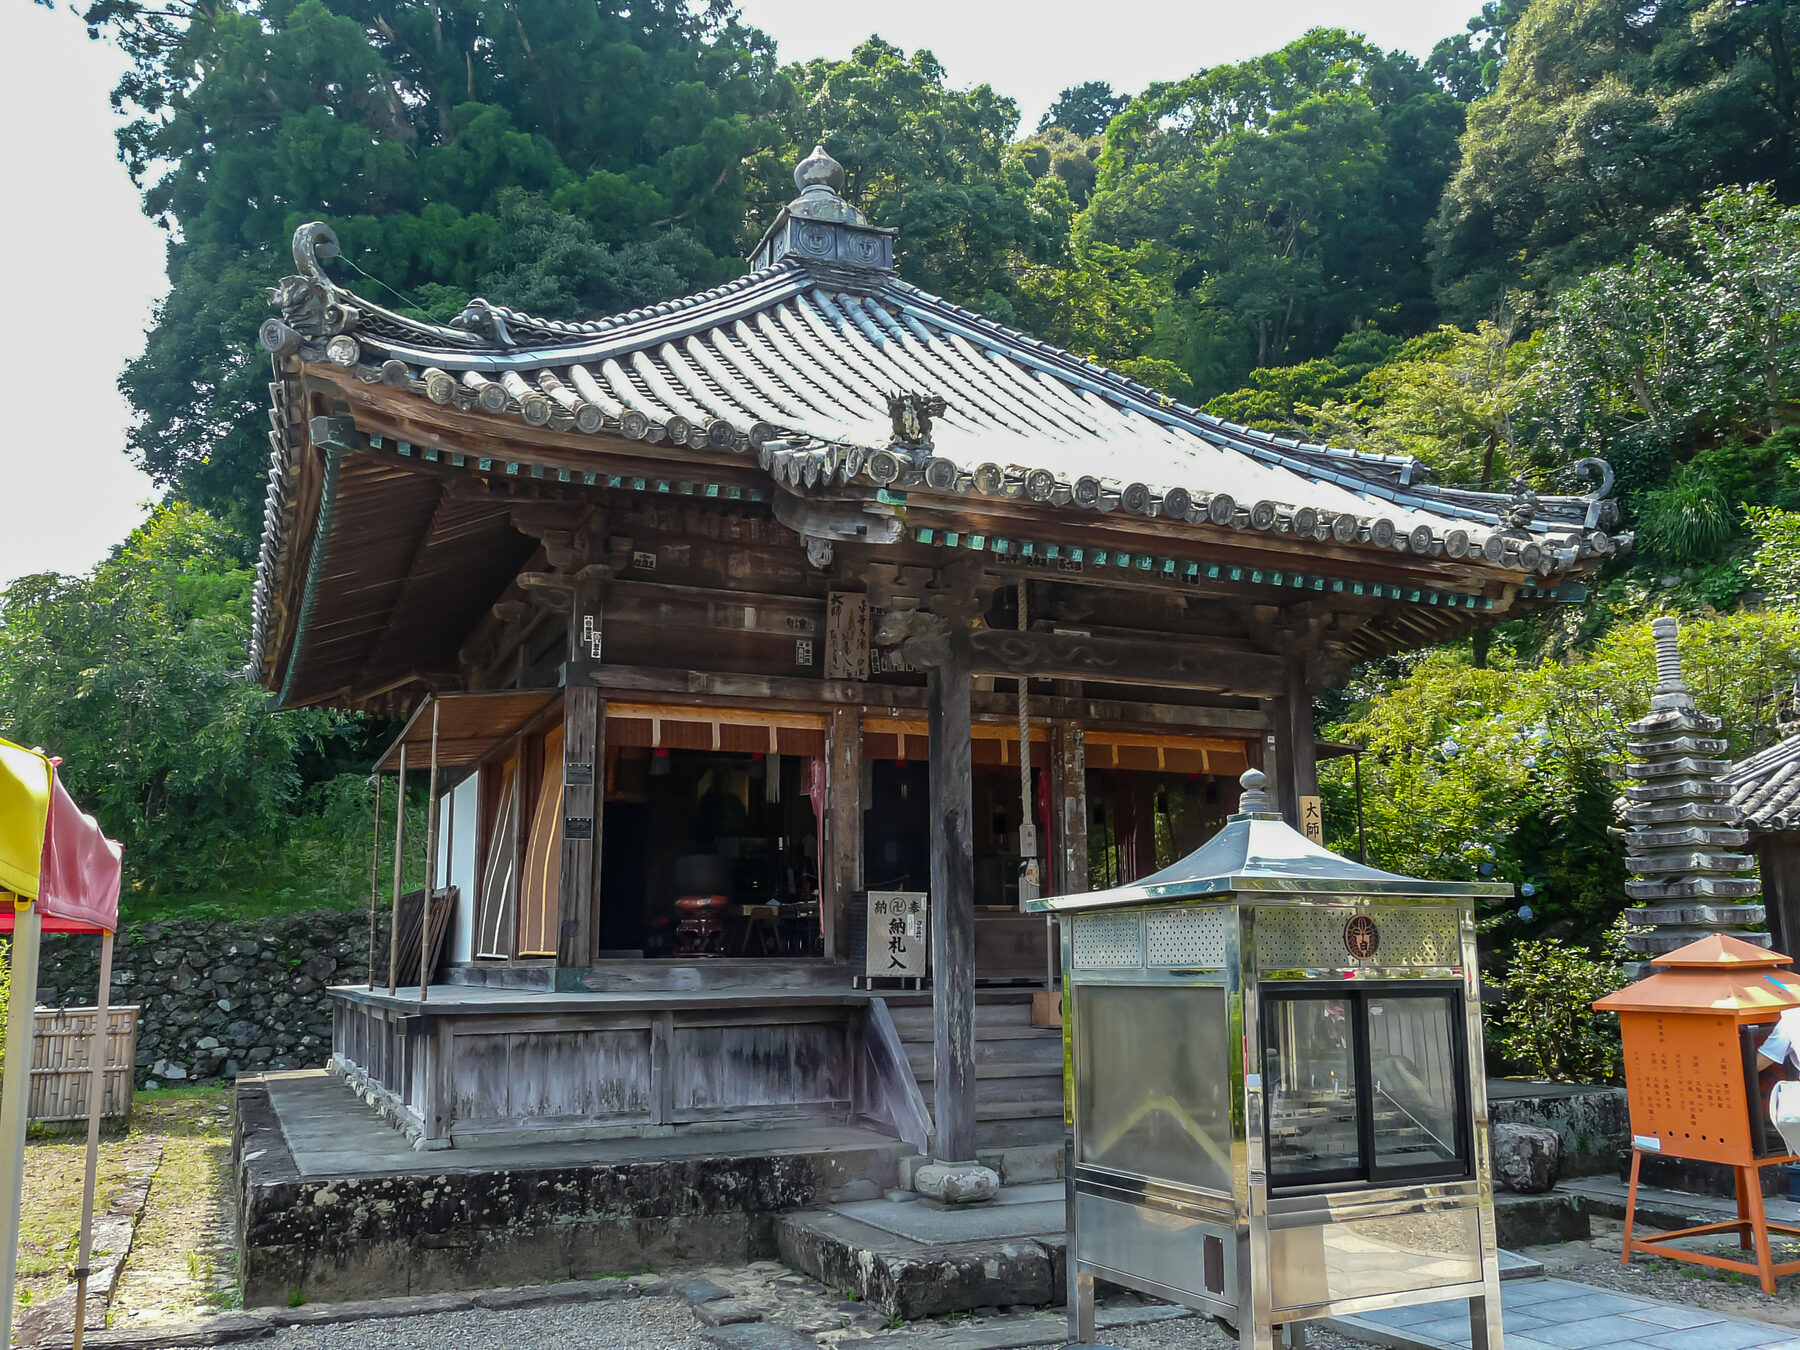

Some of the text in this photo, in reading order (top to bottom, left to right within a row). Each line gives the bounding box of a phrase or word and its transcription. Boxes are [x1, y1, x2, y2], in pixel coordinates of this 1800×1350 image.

[1305, 801, 1319, 838] 大師
[887, 917, 907, 969] 納札入
